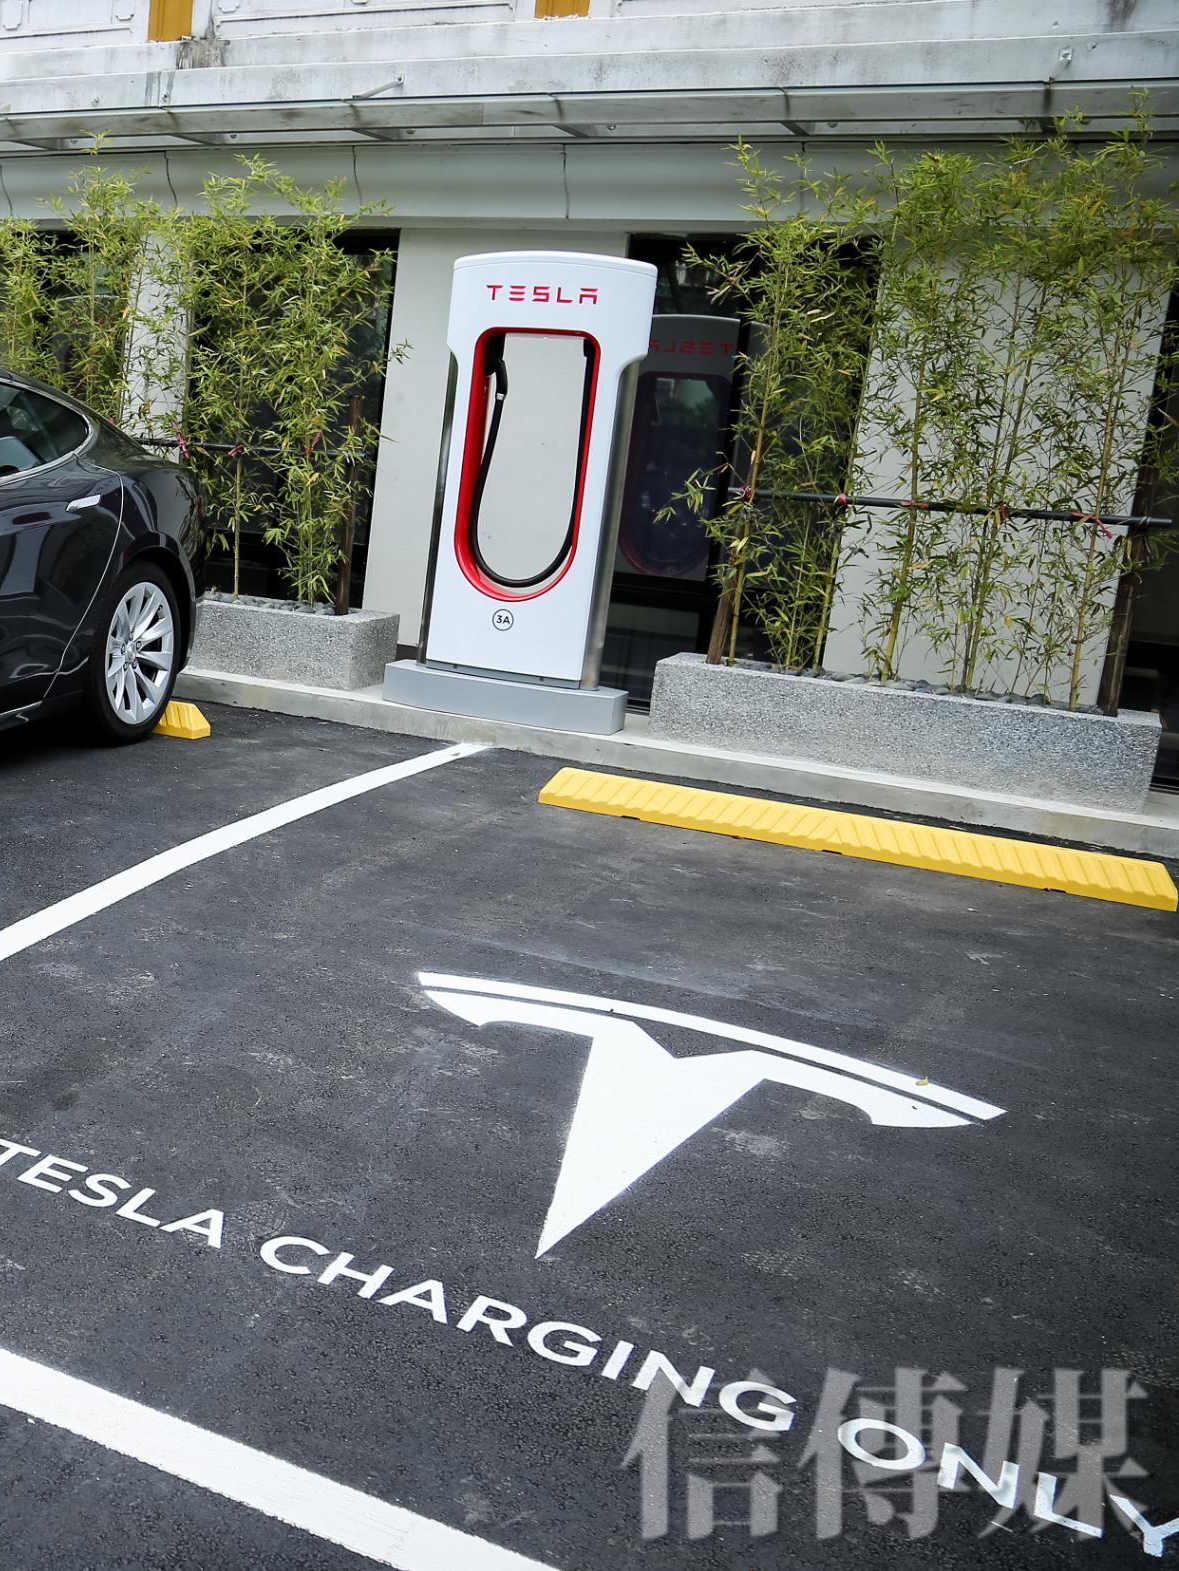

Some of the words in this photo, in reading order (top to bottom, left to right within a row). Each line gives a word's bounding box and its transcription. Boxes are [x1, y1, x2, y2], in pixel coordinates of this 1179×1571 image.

[486, 284, 599, 305] TESLA
[496, 614, 511, 624] 3A
[259, 1235, 798, 1432] CHARGING
[837, 1418, 1179, 1557] ONLY
